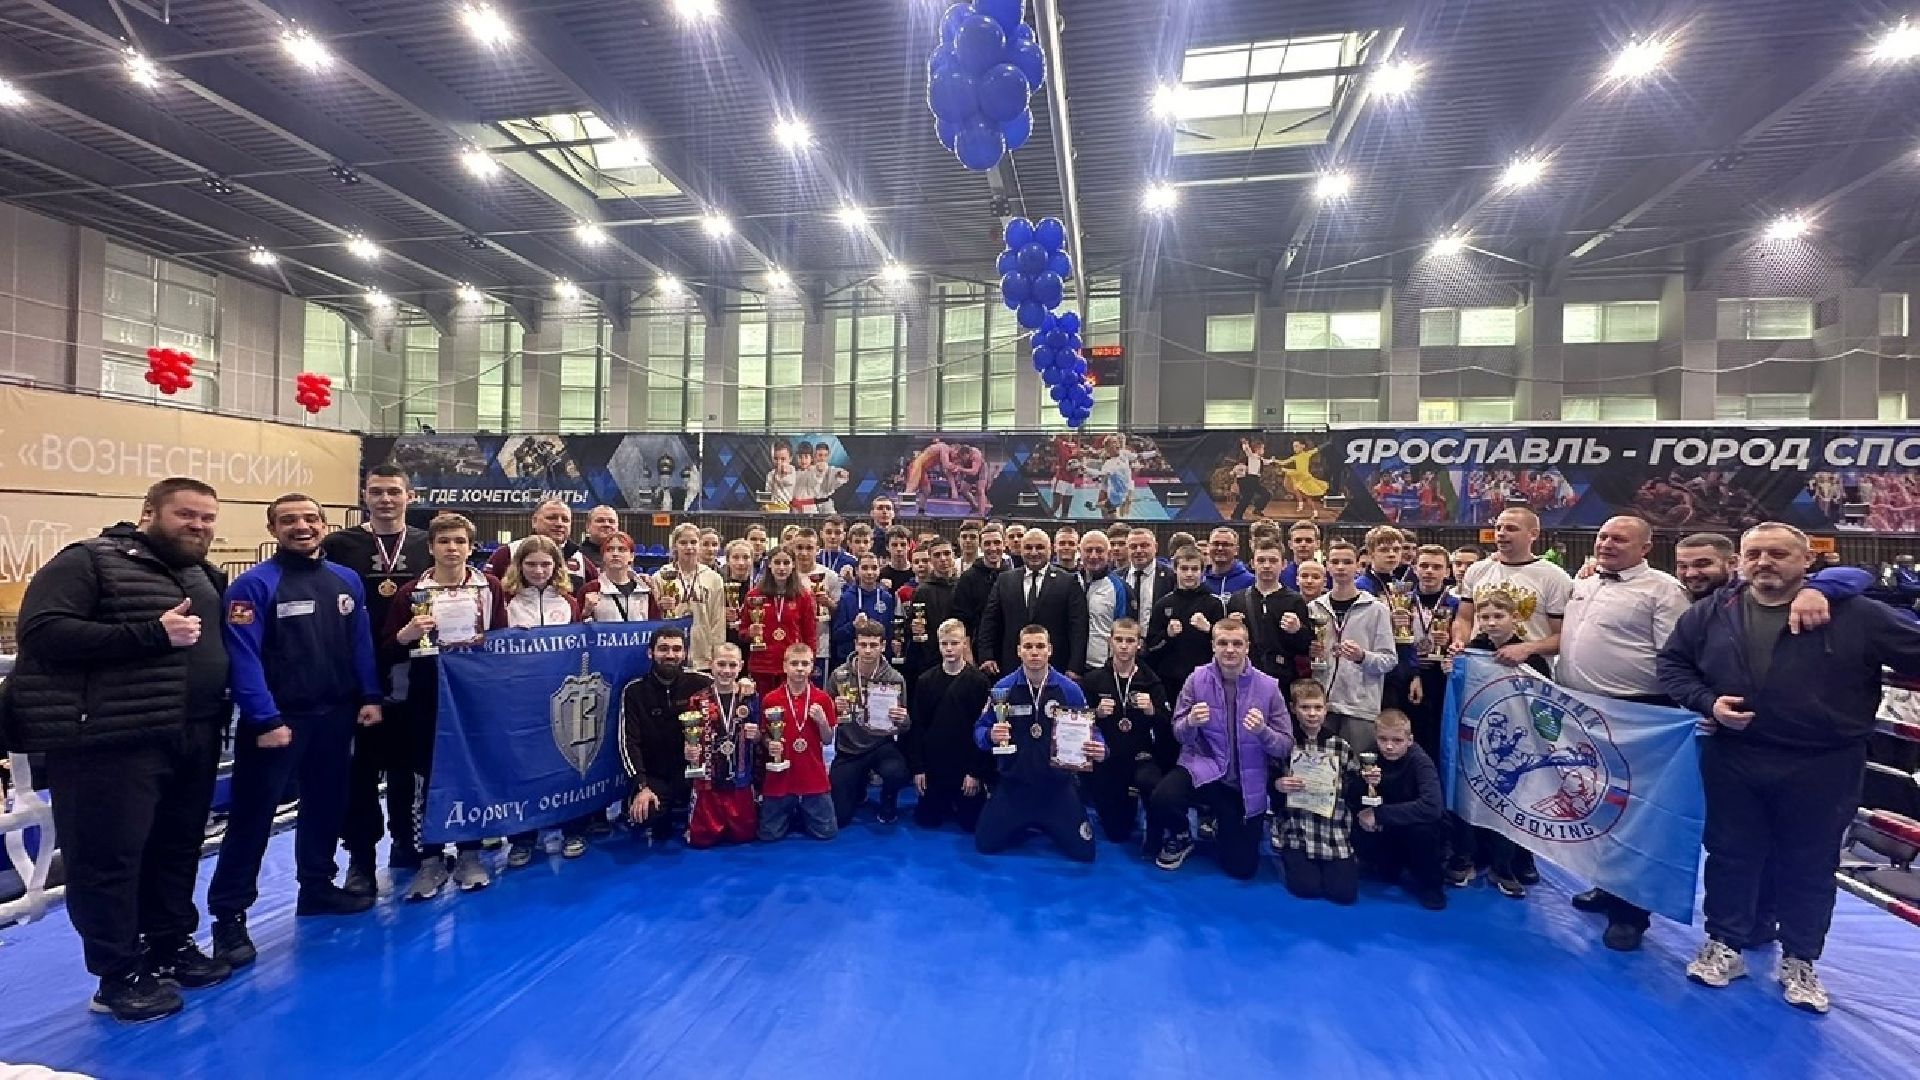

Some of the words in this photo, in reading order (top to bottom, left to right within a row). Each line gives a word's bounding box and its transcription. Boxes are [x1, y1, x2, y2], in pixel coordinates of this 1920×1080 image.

[17, 434, 313, 487] «ВОЗНЕСЕНСКИЙ»
[1344, 437, 1611, 467] ЯРОСЛАВЛЬ
[1648, 437, 1811, 472] ГОРОД
[429, 488, 458, 505] ГДЕ
[459, 488, 530, 503] ХОЧЕТСЯ
[1470, 774, 1510, 815] KICK
[1514, 813, 1595, 840] BOXING
